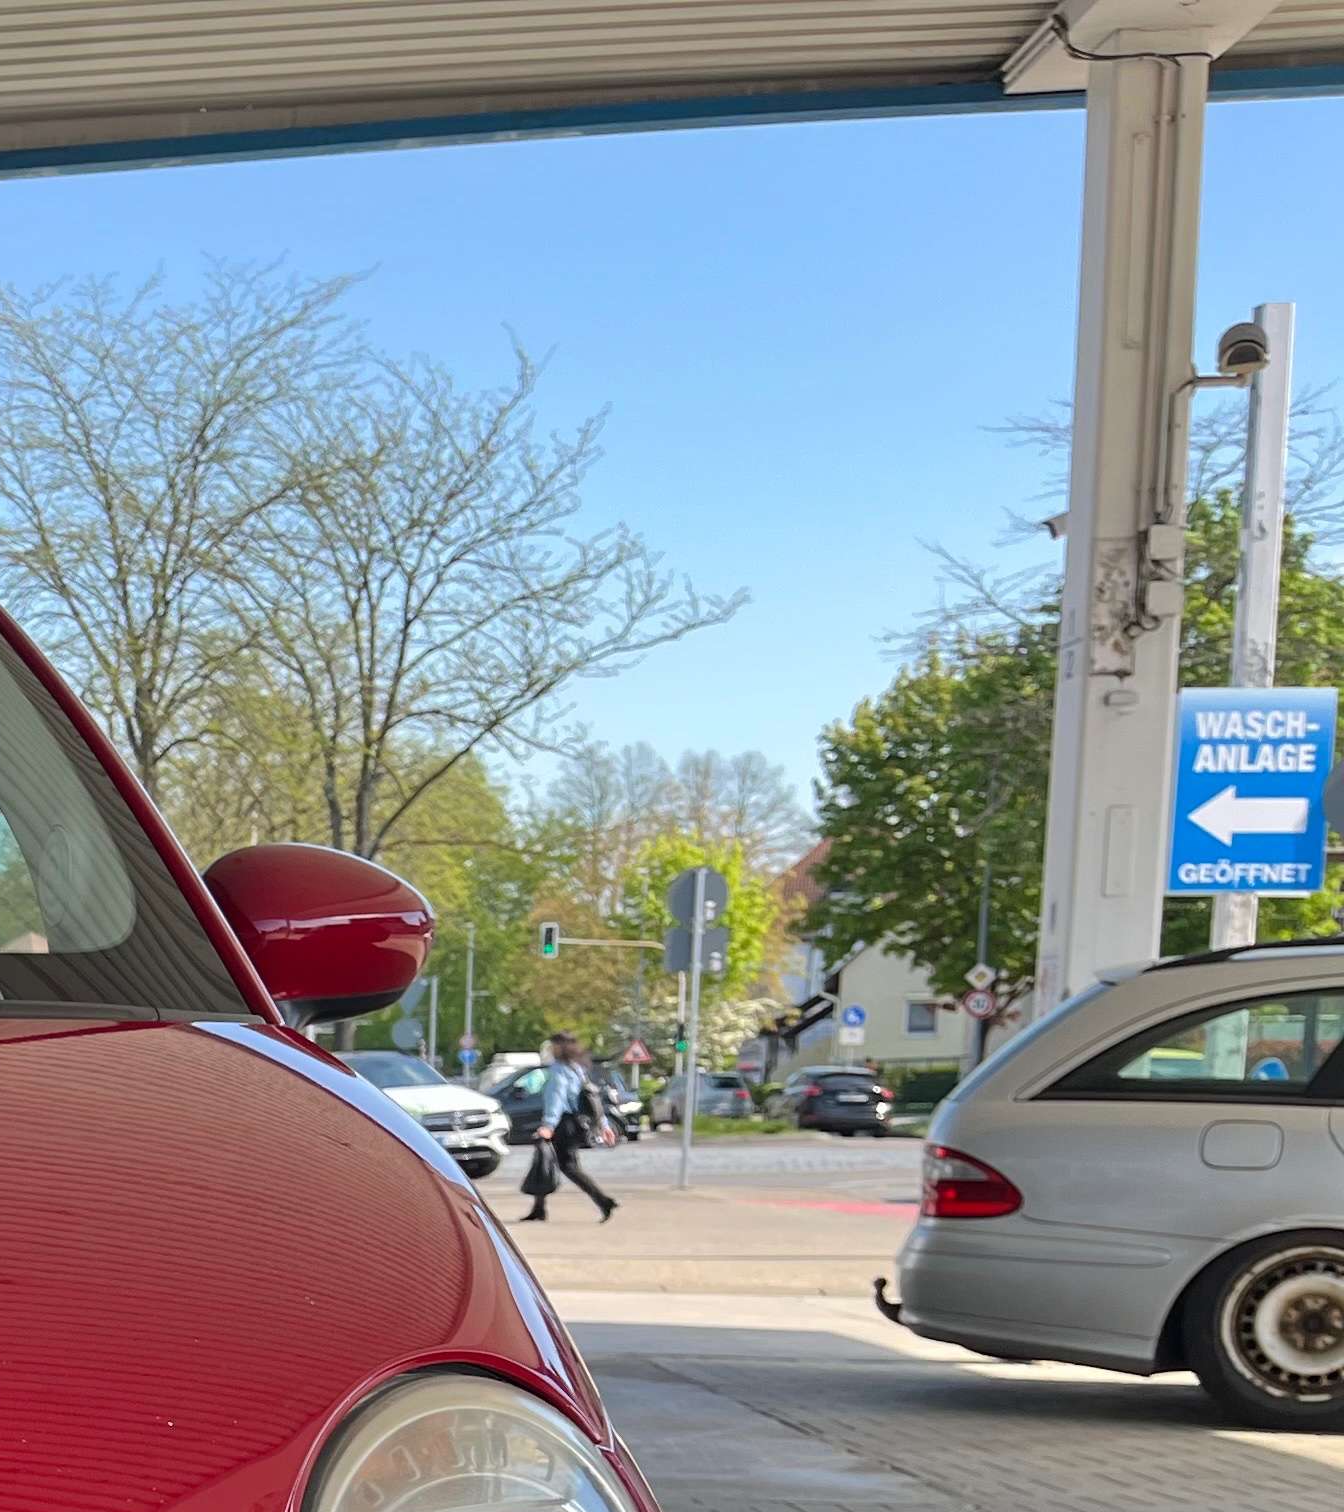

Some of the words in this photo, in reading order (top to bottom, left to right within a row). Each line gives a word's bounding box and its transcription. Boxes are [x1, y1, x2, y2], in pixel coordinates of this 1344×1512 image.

[1195, 711, 1320, 739] WASCH-
[1193, 744, 1316, 772] ANLAGE
[1178, 859, 1313, 884] GEÖFFNET
